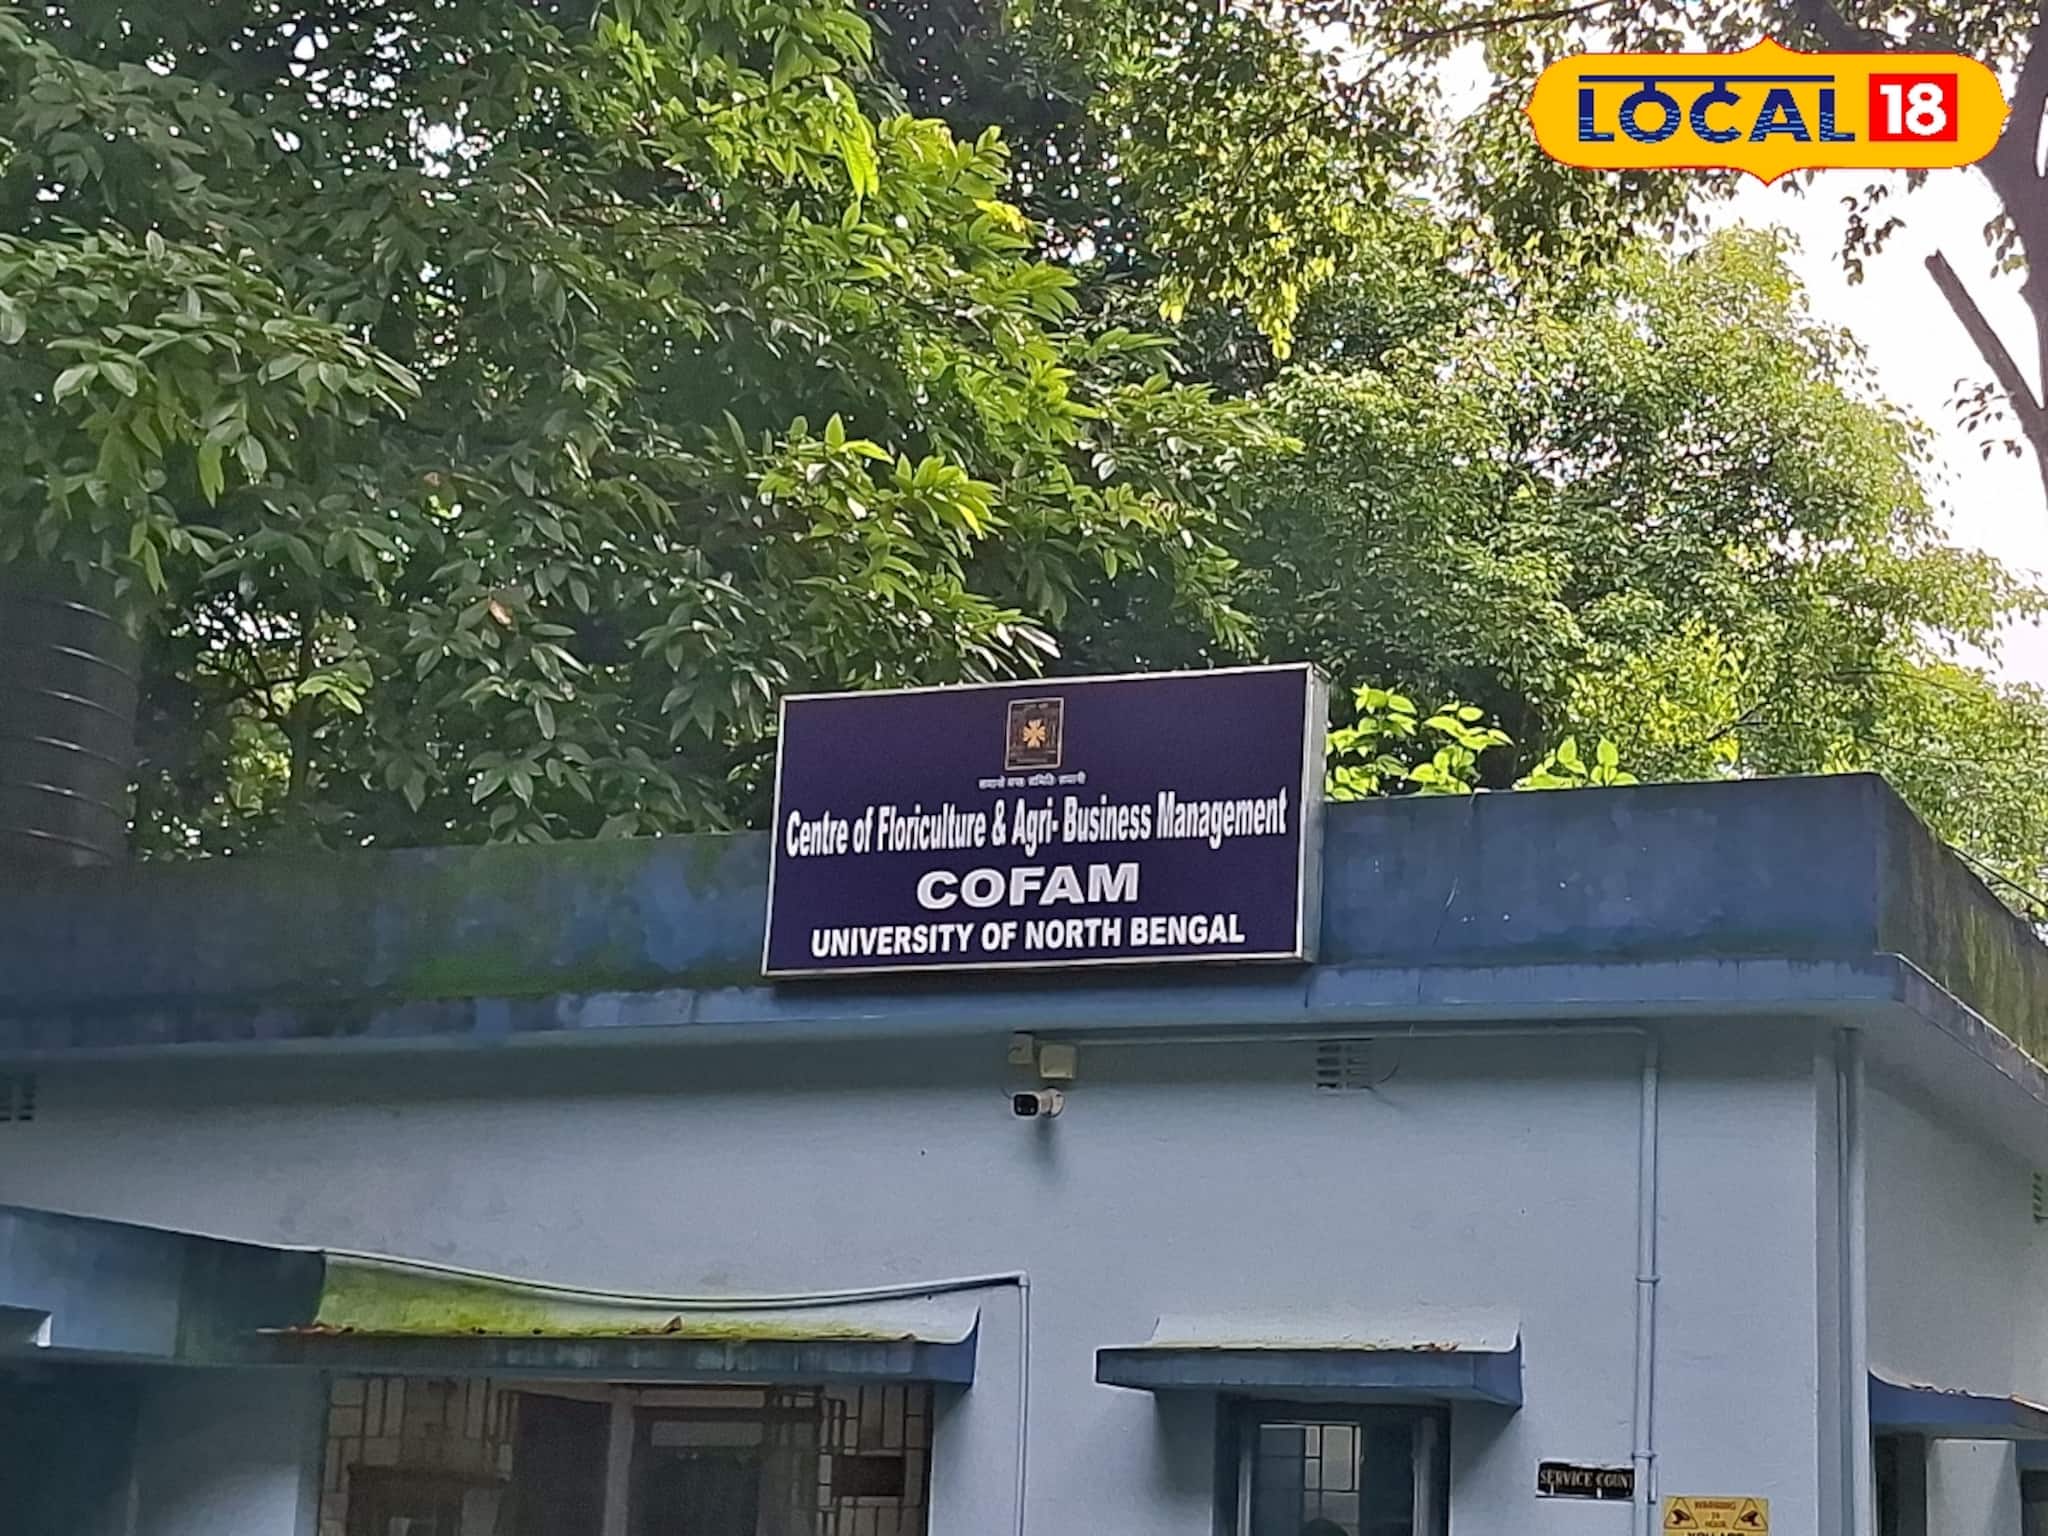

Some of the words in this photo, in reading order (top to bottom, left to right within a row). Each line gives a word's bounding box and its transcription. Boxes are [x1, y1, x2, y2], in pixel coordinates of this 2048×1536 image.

[786, 810, 849, 857] Centre
[853, 805, 875, 853] of
[877, 803, 987, 851] Floriculture
[991, 799, 1006, 847] &
[1011, 796, 1059, 857] Agri-
[1062, 794, 1152, 843] Business
[1156, 786, 1288, 850] Management
[916, 862, 1139, 910] COFAM
[811, 922, 975, 958] UNIVERSITY
[981, 920, 1018, 951] OF
[1025, 917, 1122, 950] NORTH
[1130, 913, 1246, 947] BENGAL
[1540, 1469, 1593, 1488] SERVICE
